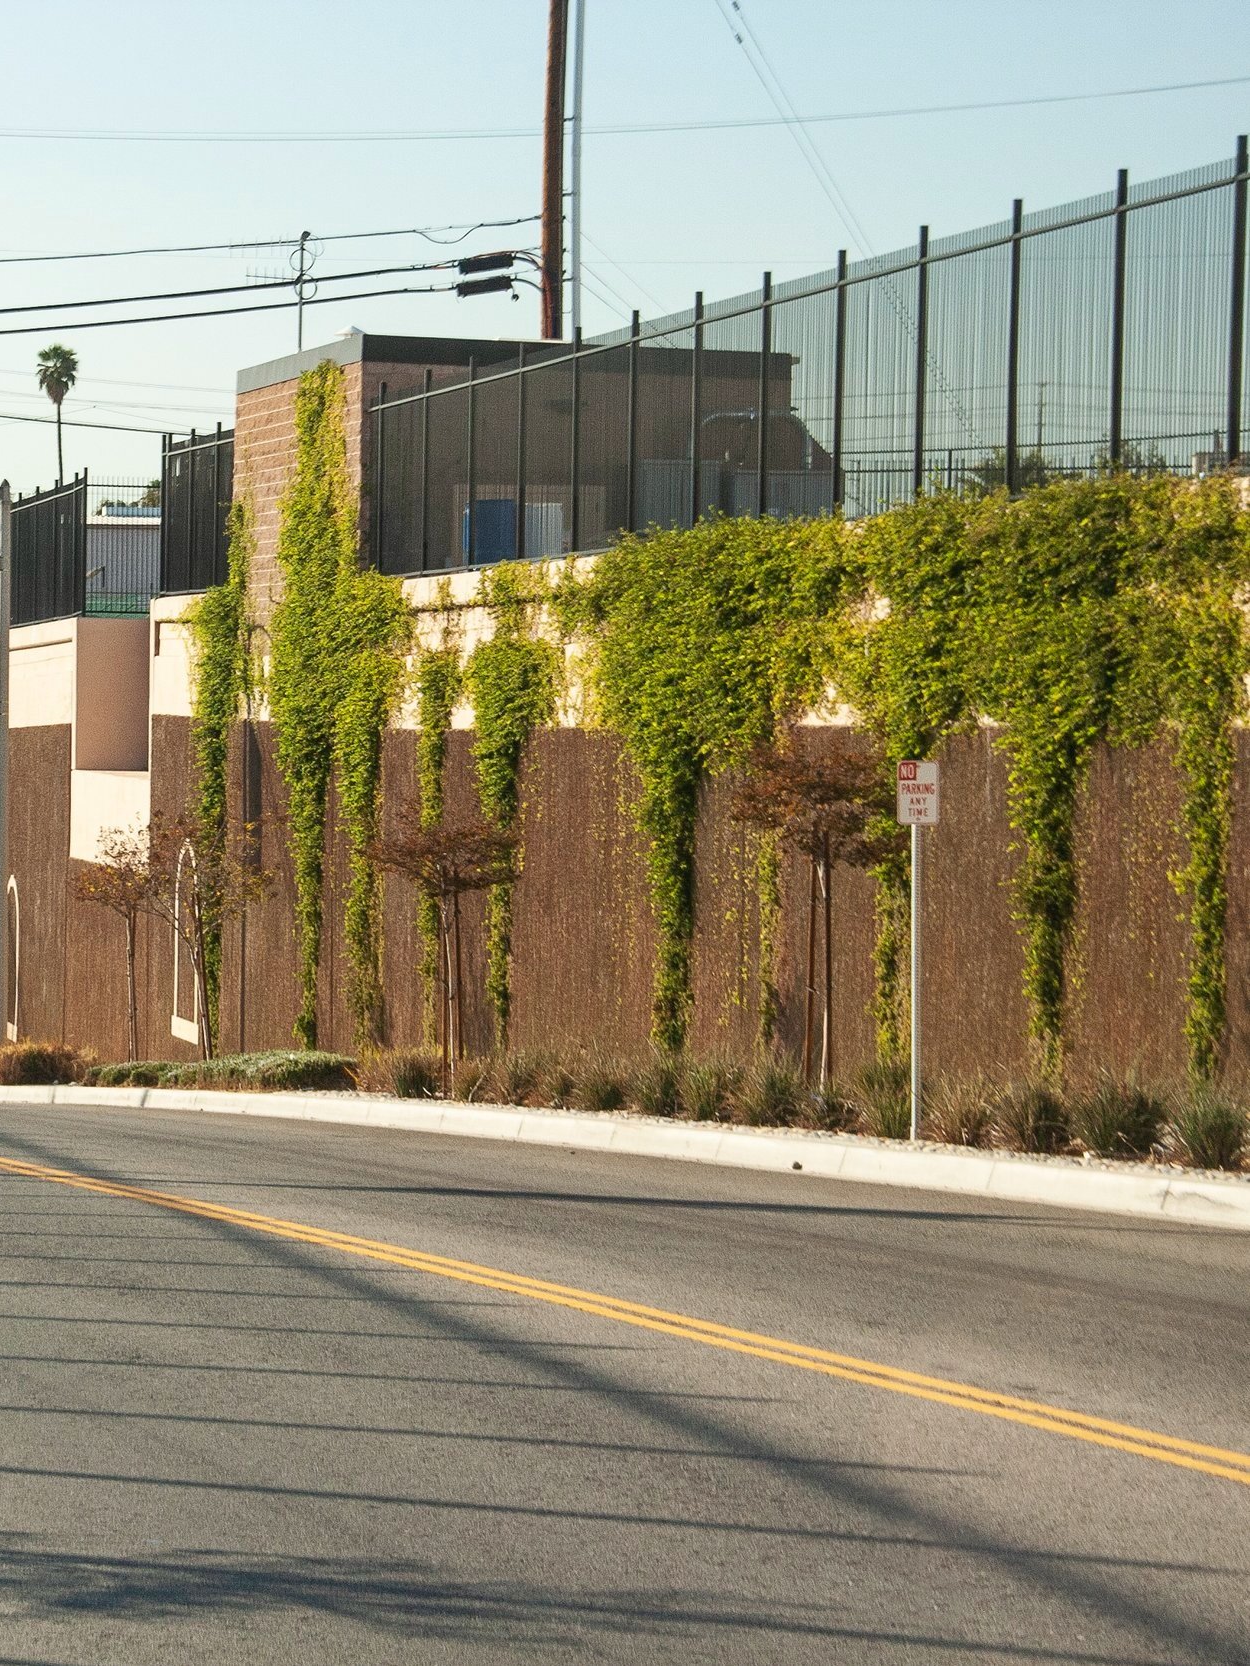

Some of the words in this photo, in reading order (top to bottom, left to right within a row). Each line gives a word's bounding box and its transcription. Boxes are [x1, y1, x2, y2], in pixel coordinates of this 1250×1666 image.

[900, 764, 915, 779] NO
[901, 783, 936, 795] PARKING
[909, 797, 927, 806] ANY
[908, 807, 929, 817] TIME
